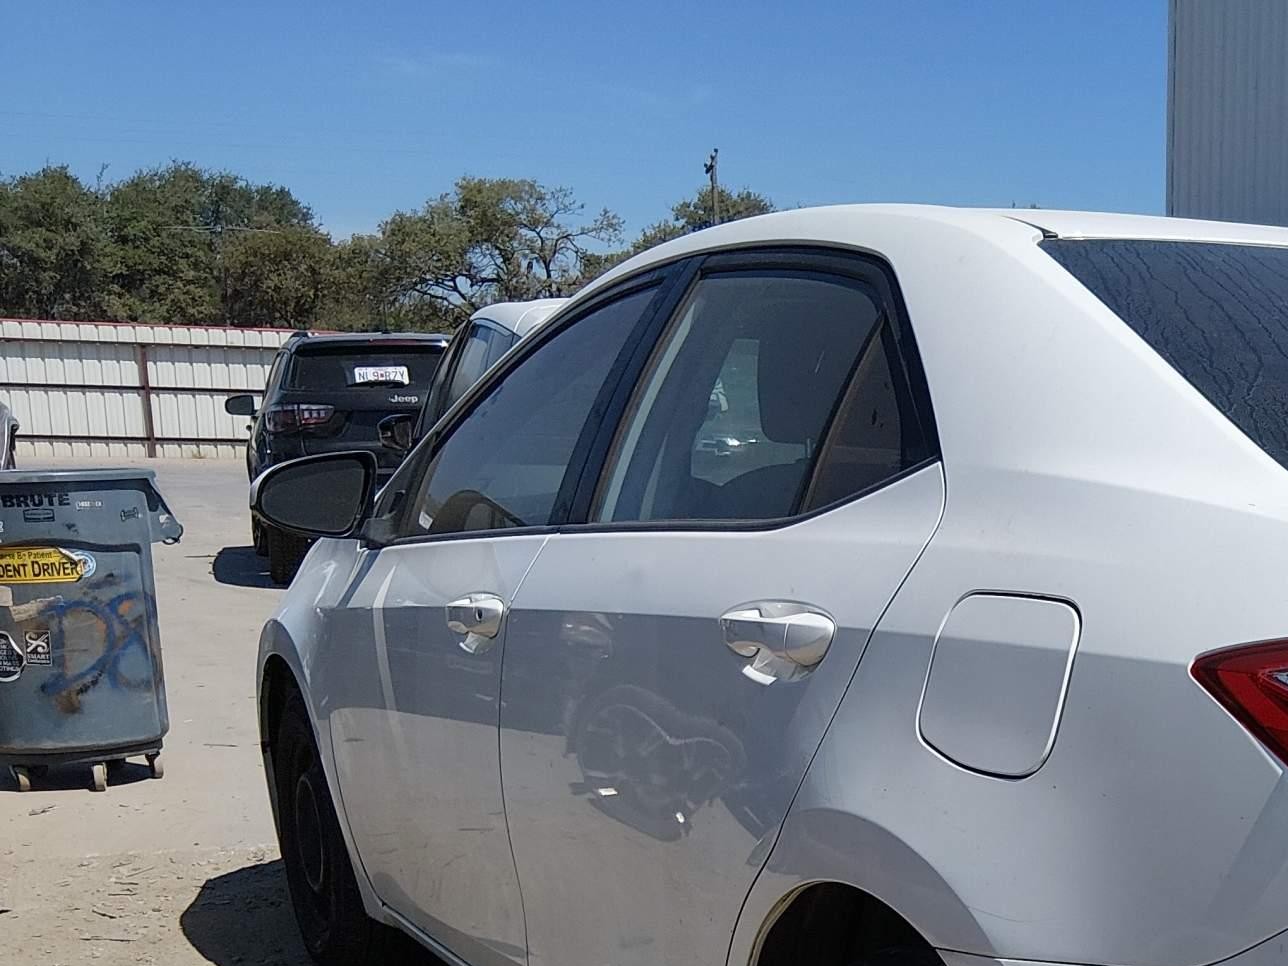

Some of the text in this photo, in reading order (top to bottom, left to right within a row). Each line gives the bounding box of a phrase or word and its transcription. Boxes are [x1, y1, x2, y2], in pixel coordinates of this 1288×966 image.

[390, 395, 418, 403] Jeep
[1, 493, 71, 508] BRUTE
[28, 551, 52, 560] Patient
